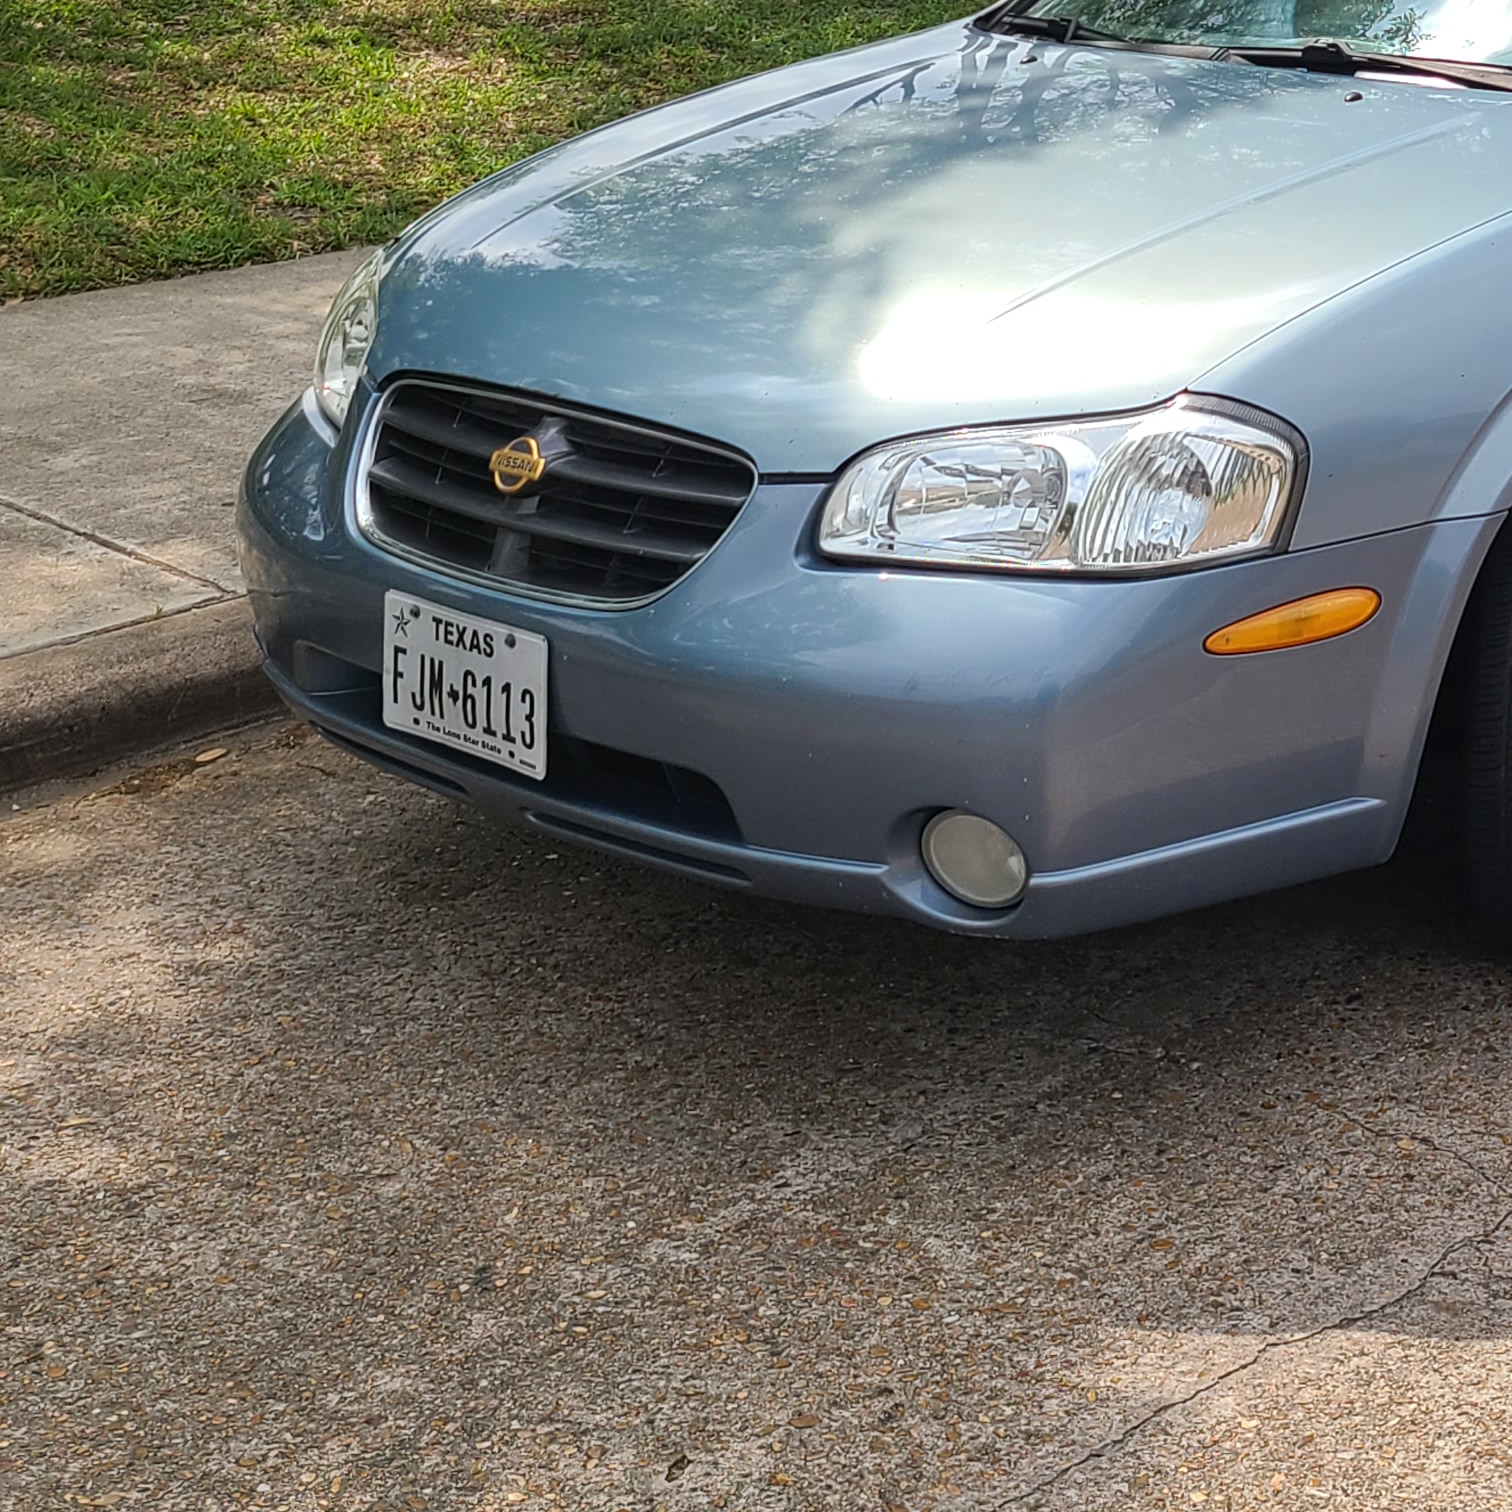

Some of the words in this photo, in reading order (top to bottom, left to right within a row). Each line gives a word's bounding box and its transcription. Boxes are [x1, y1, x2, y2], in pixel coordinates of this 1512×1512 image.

[497, 455, 535, 473] NISSAN
[432, 616, 494, 658] TEXAS
[462, 669, 535, 750] 6113
[426, 721, 440, 733] The
[463, 733, 479, 746] Star
[481, 740, 502, 755] State
